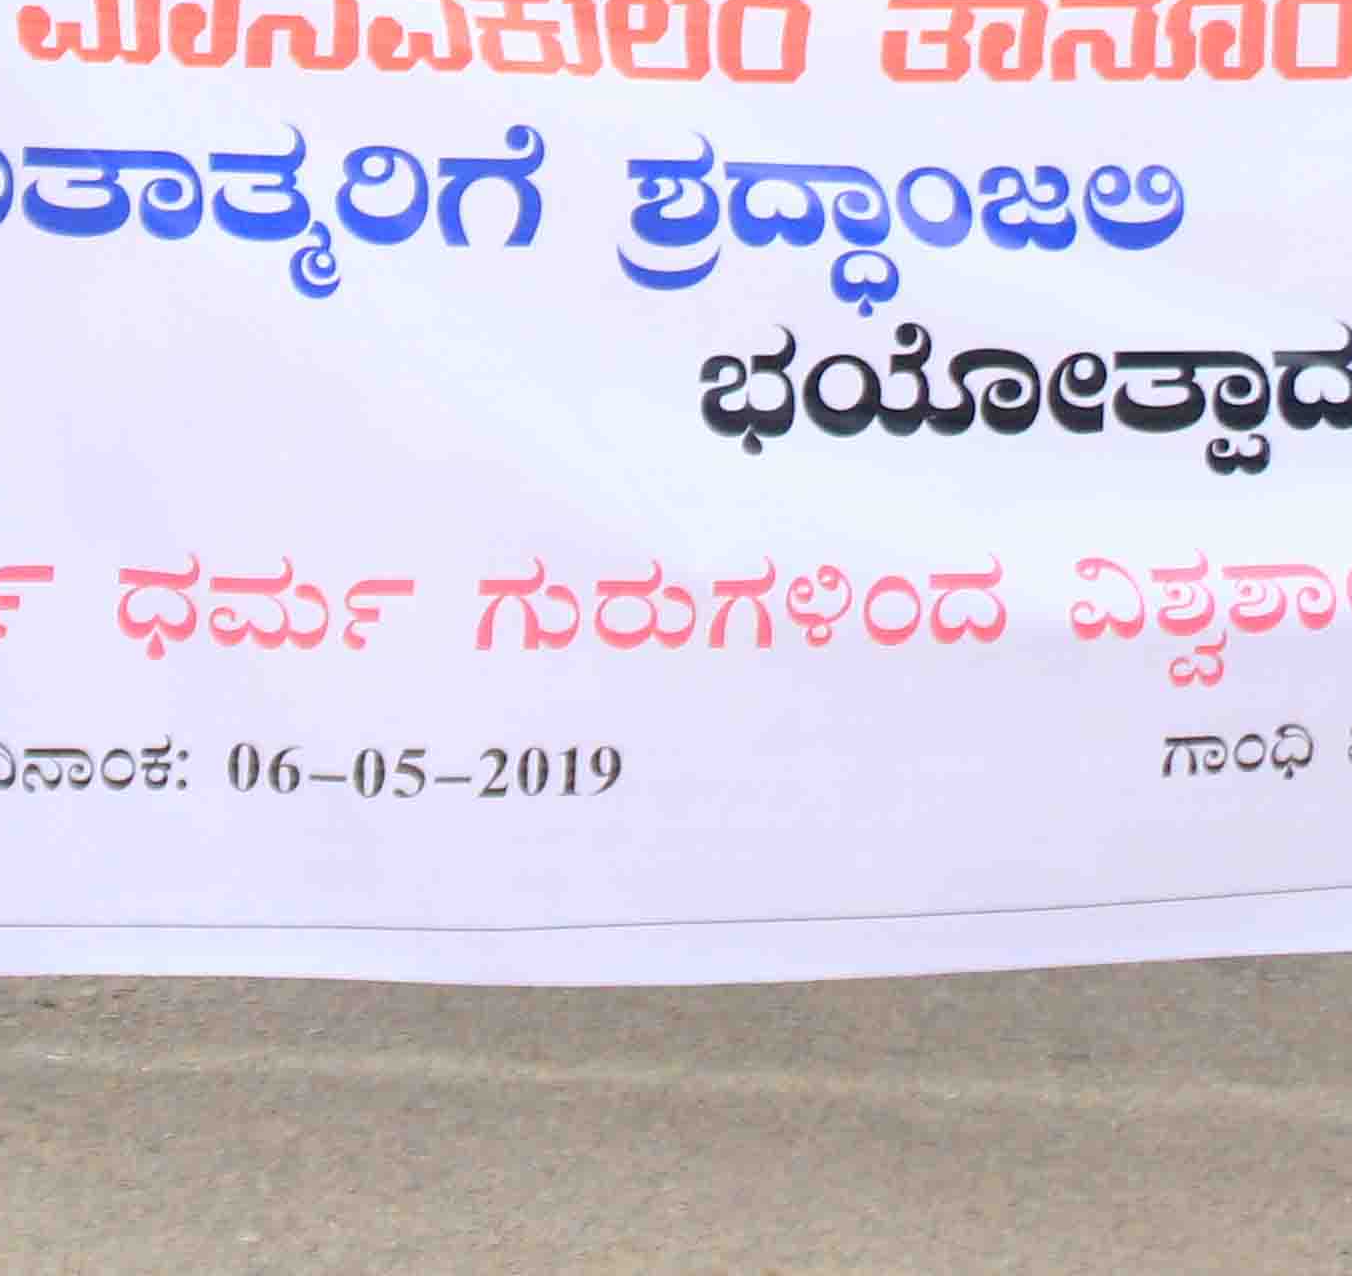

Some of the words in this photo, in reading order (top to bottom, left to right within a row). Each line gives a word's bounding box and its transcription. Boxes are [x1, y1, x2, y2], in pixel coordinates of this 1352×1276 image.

[617, 132, 1185, 318] ಶ್ರದ್ಧಾಂಜಲಿ
[118, 556, 414, 660] ಧರ್ಮ
[476, 557, 1008, 650] ಗುರುಗಳಿಂದ
[228, 743, 622, 798] 06-05-2019
[1162, 722, 1315, 781] ಗಾಂಧಿ
